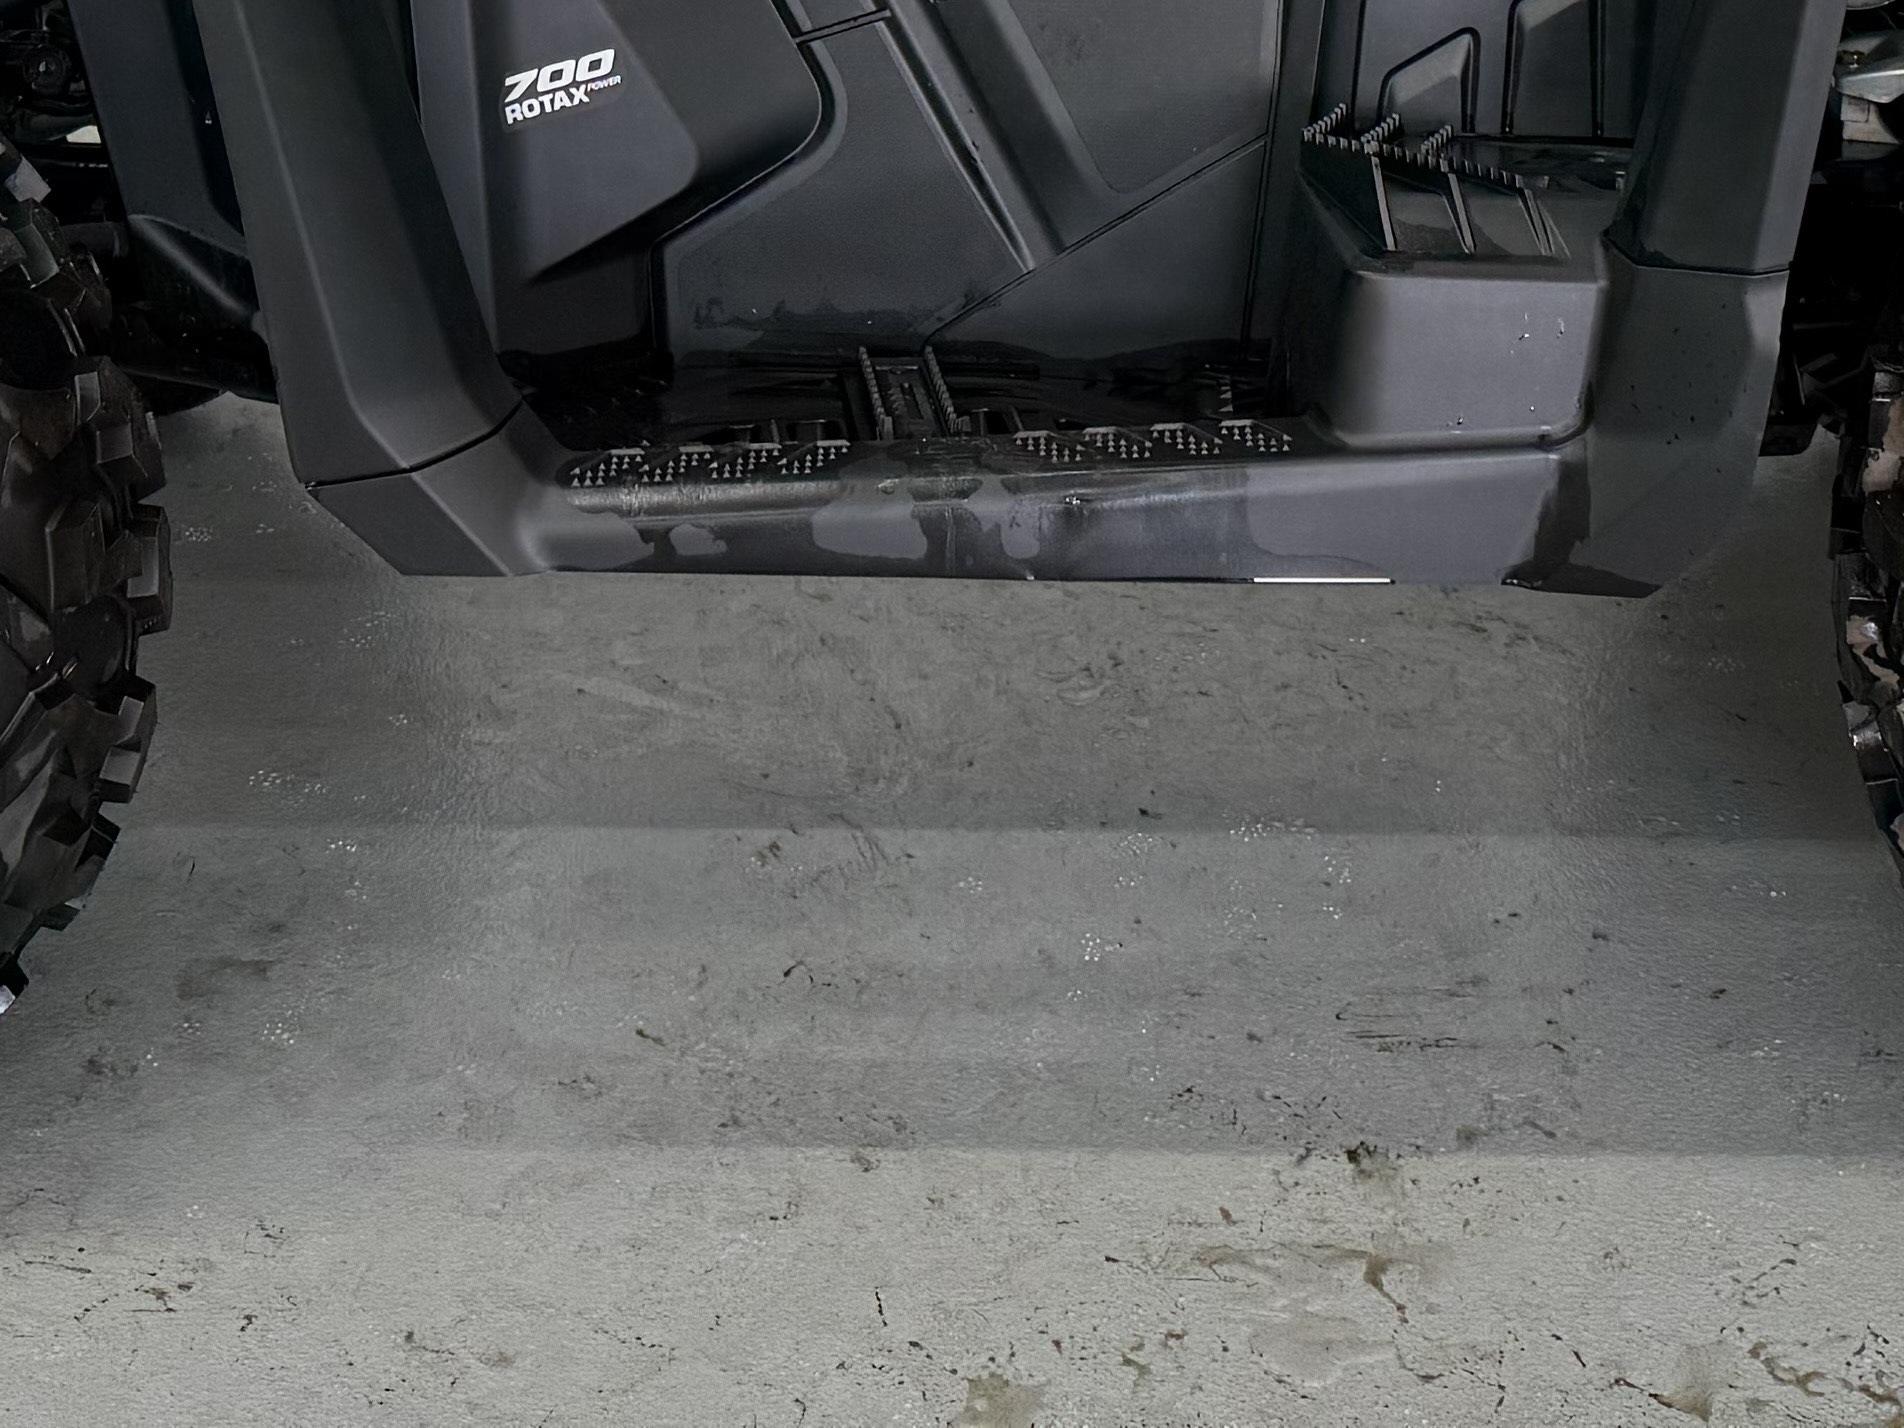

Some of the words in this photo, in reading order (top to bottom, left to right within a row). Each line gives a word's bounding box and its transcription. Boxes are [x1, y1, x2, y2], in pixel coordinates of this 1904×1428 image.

[504, 49, 615, 103] 700
[505, 85, 590, 124] ROTAX
[587, 75, 621, 92] POWER
